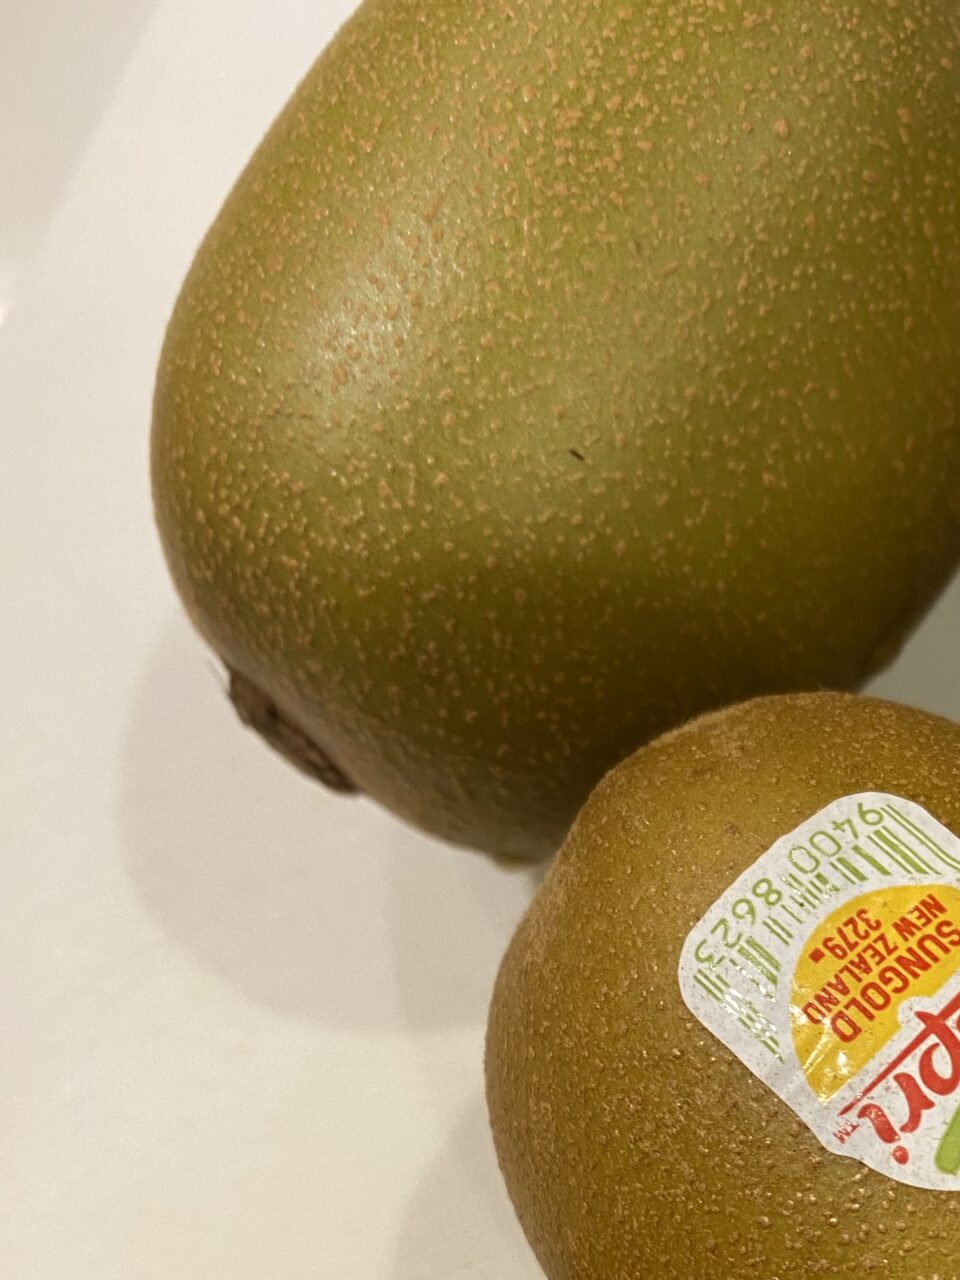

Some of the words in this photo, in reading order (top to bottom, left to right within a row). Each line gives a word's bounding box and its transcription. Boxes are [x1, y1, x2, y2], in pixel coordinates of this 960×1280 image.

[787, 802, 884, 874] 9400
[695, 878, 783, 971] 8623
[822, 908, 881, 961] 3279
[892, 893, 948, 941] NEW
[802, 932, 898, 1025] ZEALAND
